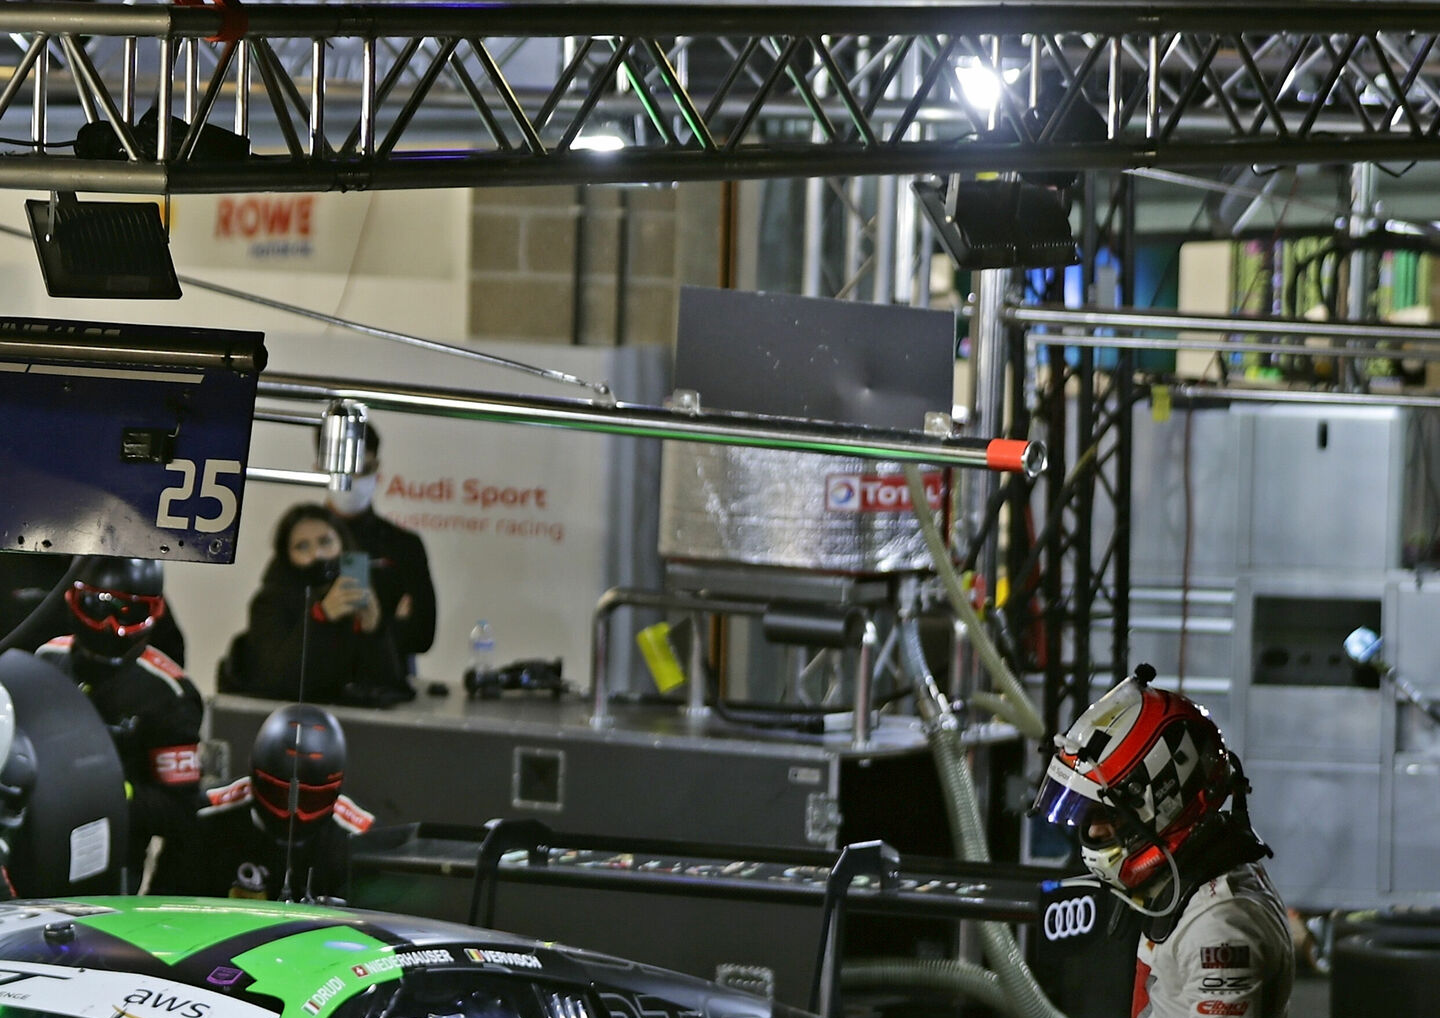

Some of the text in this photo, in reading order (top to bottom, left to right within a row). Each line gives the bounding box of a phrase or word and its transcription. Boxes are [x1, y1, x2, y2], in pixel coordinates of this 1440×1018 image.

[216, 195, 316, 239] ROWE
[156, 458, 242, 533] 25
[386, 473, 549, 510] Audi Sport
[364, 949, 455, 975] NIEDERHAUSER
[481, 949, 543, 969] VERVISCH
[314, 975, 347, 1006] DRUDI
